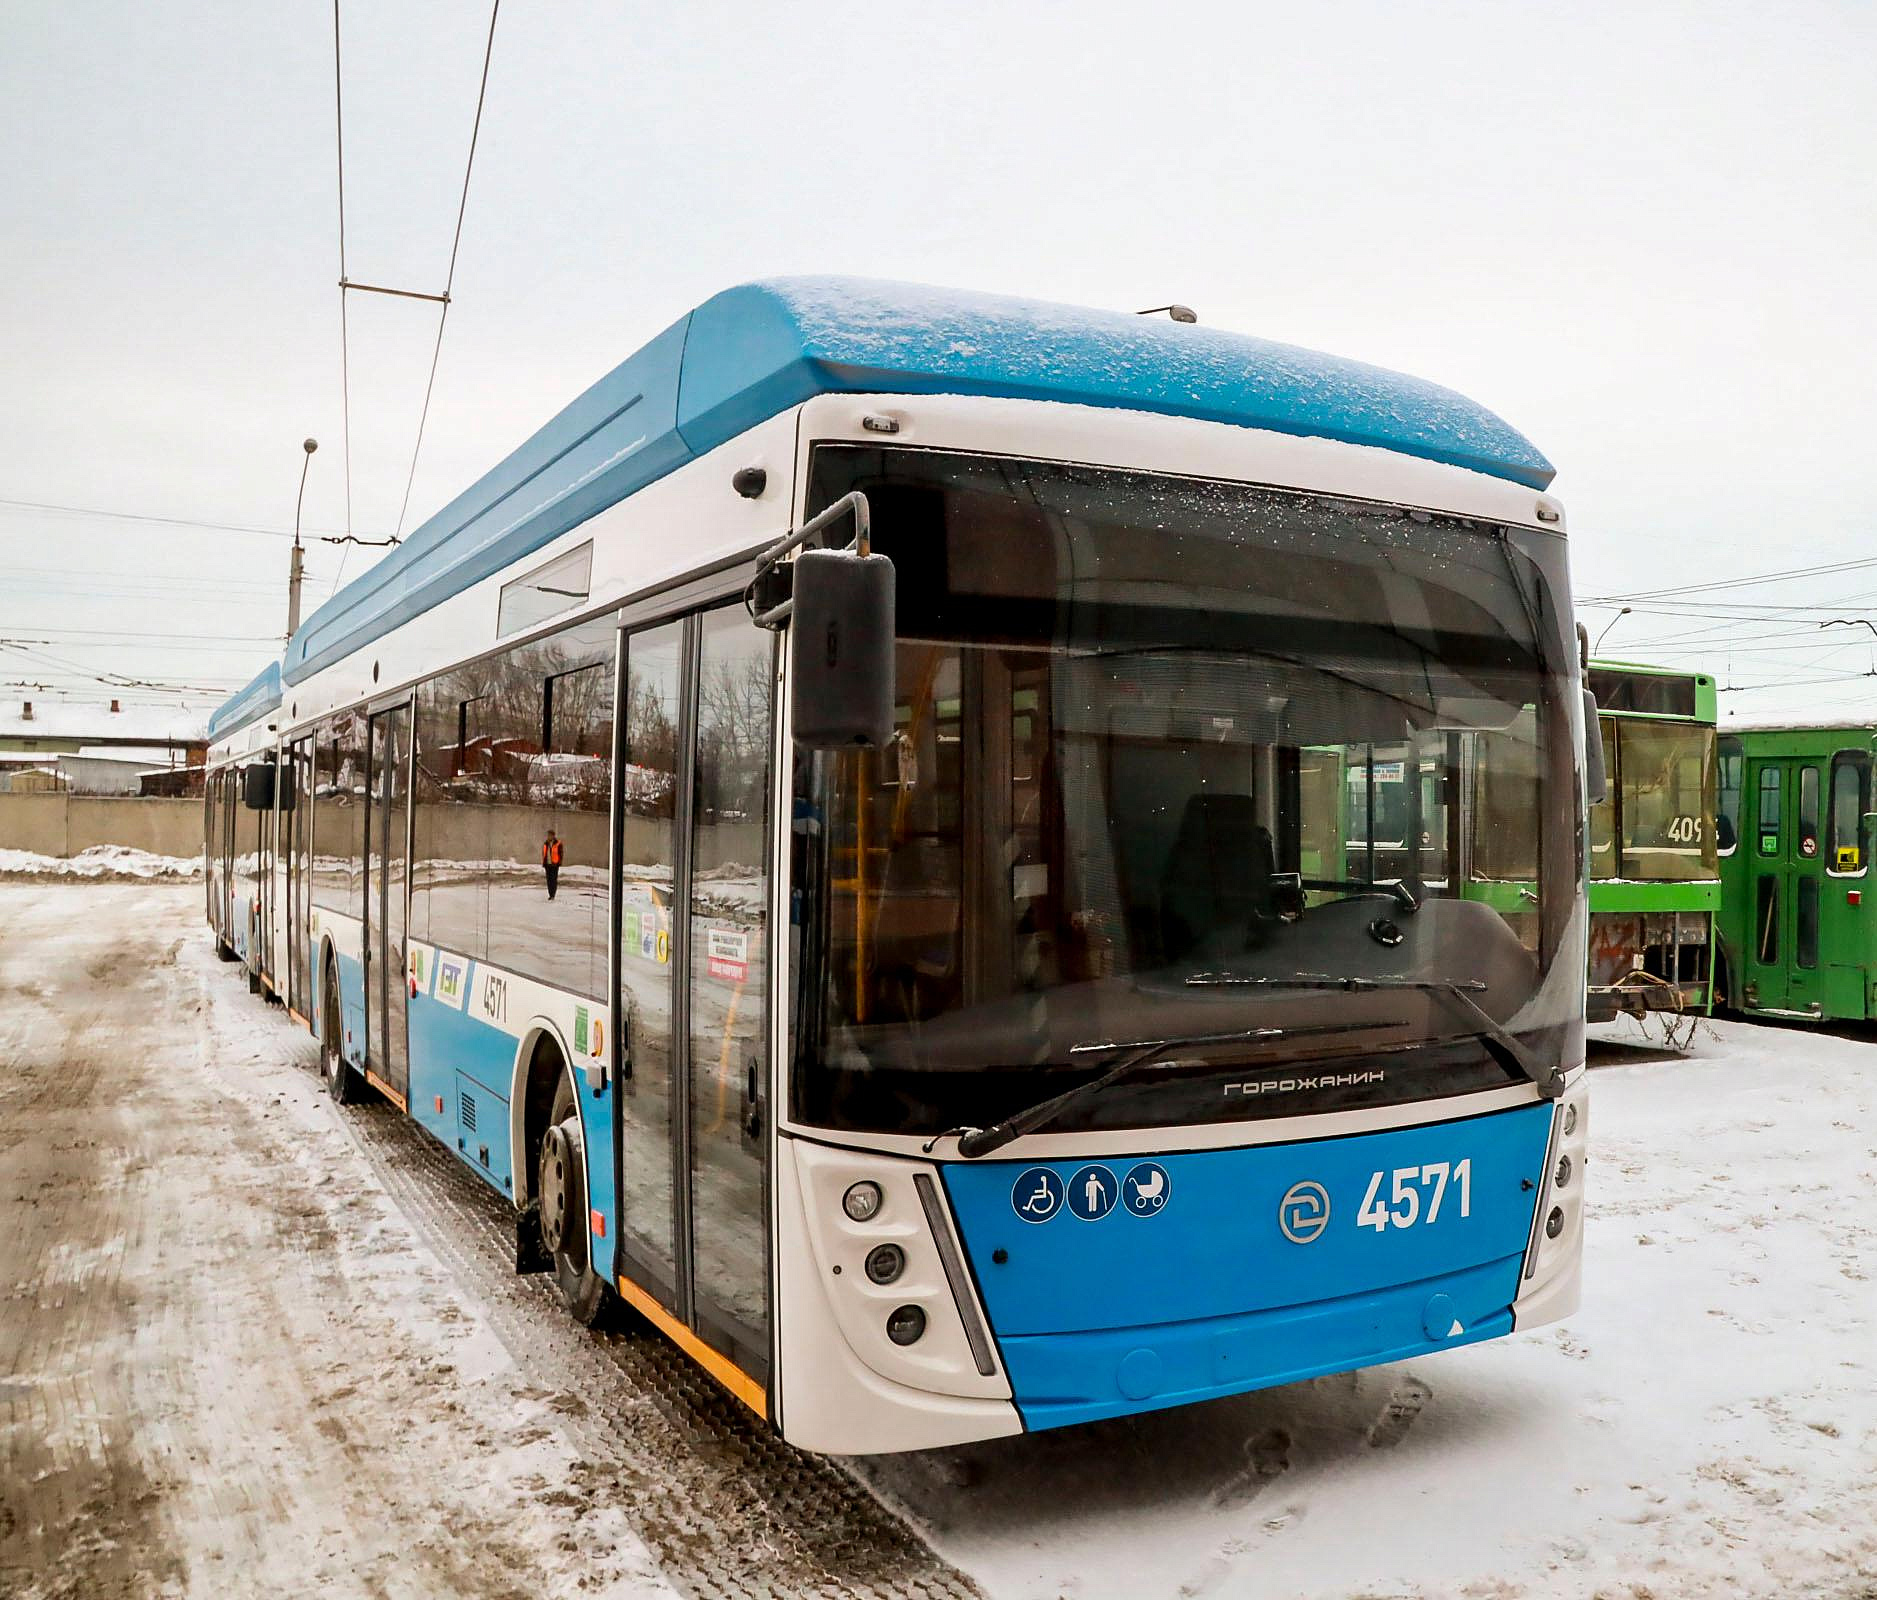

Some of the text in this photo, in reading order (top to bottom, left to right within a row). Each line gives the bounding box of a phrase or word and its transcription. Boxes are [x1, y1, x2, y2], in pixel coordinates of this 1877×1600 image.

[484, 974, 507, 1024] 4571
[1224, 1070, 1384, 1096] ГОРОЖАНИН
[1357, 1158, 1471, 1232] 4571
